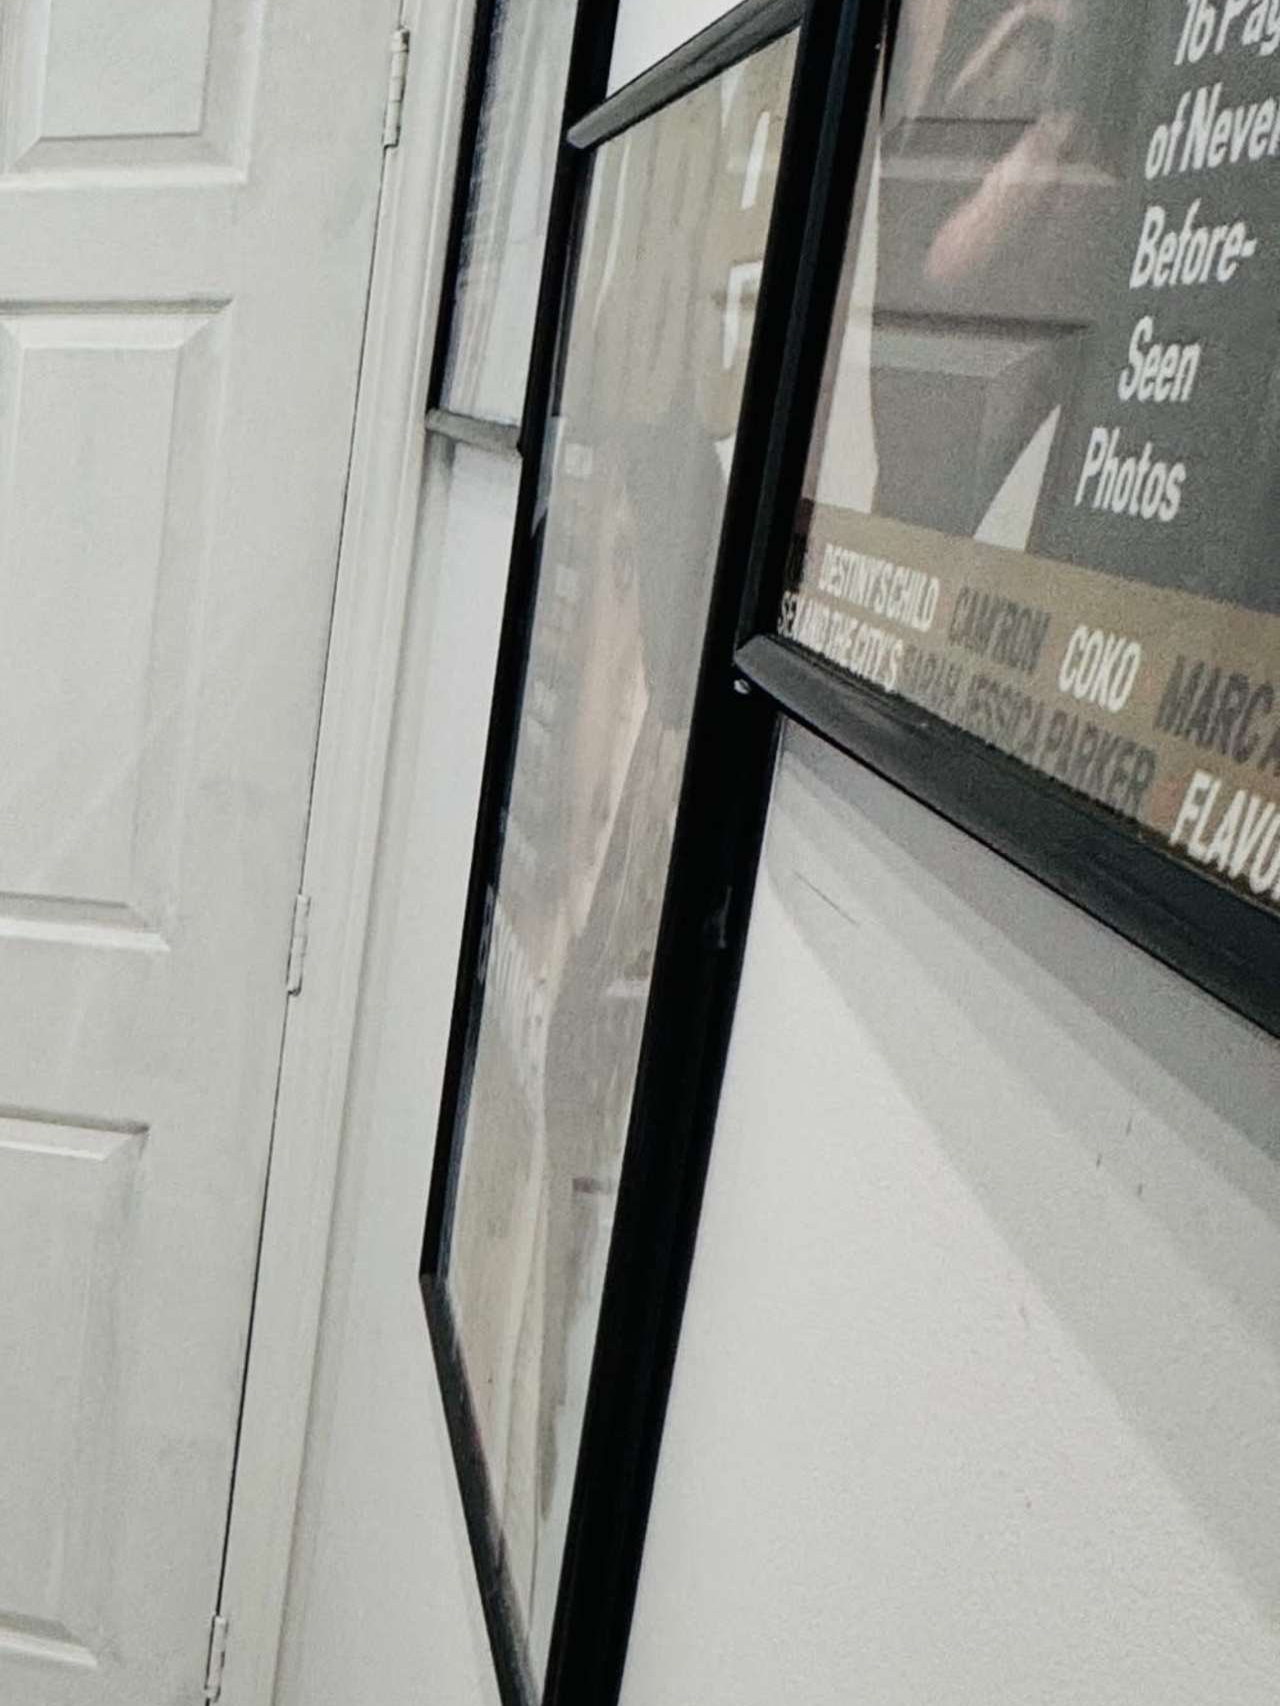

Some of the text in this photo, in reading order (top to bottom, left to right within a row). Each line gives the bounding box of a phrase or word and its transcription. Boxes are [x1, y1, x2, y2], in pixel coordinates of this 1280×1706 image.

[1144, 90, 1193, 179] of
[1128, 197, 1258, 290] Before-
[1118, 315, 1203, 403] Seen
[1073, 425, 1187, 523] Photos
[885, 565, 942, 633] CHILD
[1058, 624, 1142, 714] COKO
